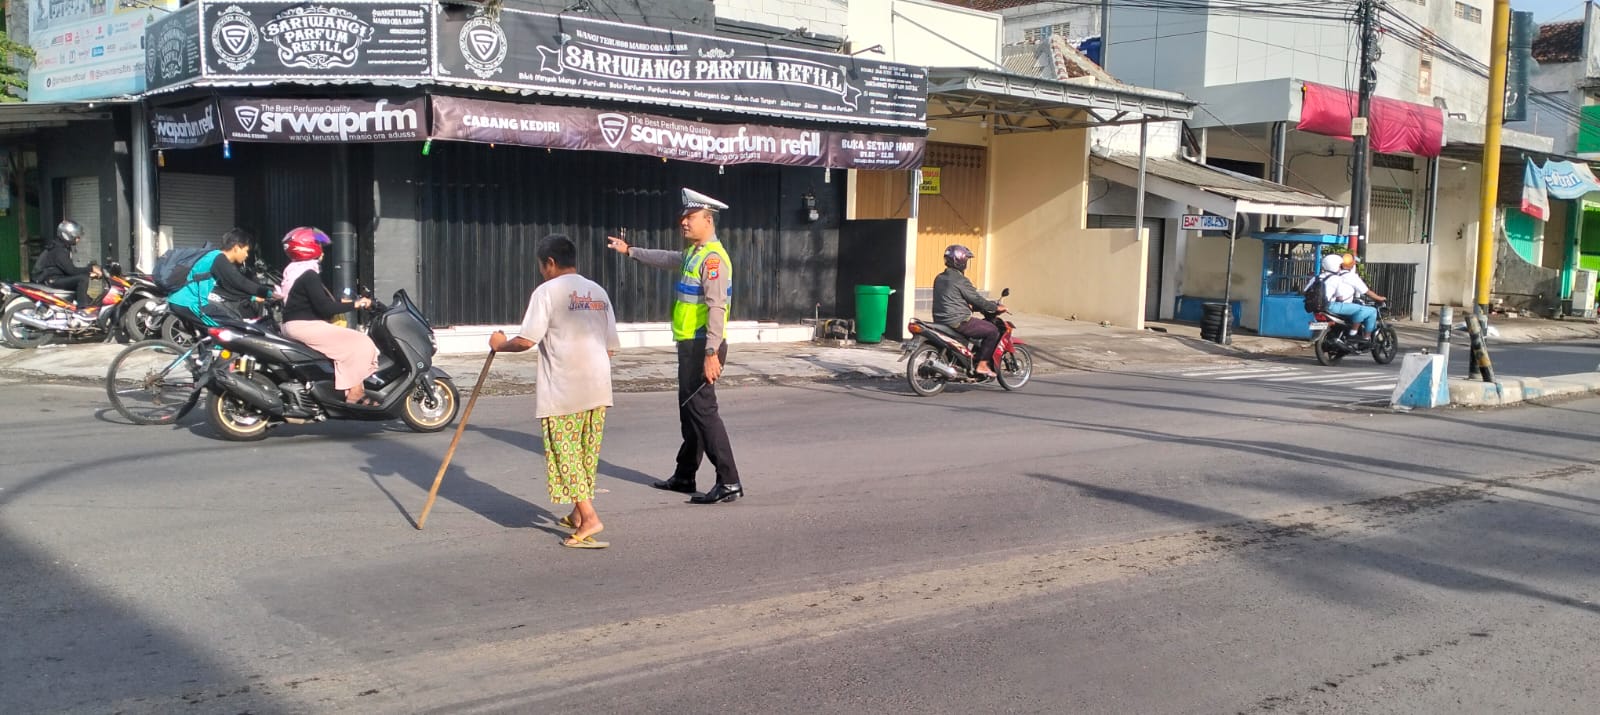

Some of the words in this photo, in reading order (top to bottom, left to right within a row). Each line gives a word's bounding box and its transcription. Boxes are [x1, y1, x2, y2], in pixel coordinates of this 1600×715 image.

[267, 15, 367, 38] SARIWANGI
[285, 28, 348, 43] PARFUM
[291, 41, 342, 54] REFILL
[565, 45, 690, 81] SARIWANGI
[695, 60, 773, 80] PARFUM
[777, 62, 843, 91] REFILL
[276, 105, 292, 113] Best
[294, 105, 324, 113] Perfume
[325, 105, 351, 114] Quality
[260, 99, 417, 142] srwaprfm
[463, 115, 518, 130] CABANG
[520, 119, 560, 132] KEDIRI
[630, 115, 643, 124] The
[645, 118, 660, 128] Best
[661, 121, 688, 132] Perfume
[689, 124, 711, 136] Quality
[630, 124, 776, 157] sarwaparfum
[781, 131, 821, 156] refill
[841, 139, 864, 150] BUKA
[866, 141, 894, 151] SETIAP
[896, 142, 915, 152] HARI
